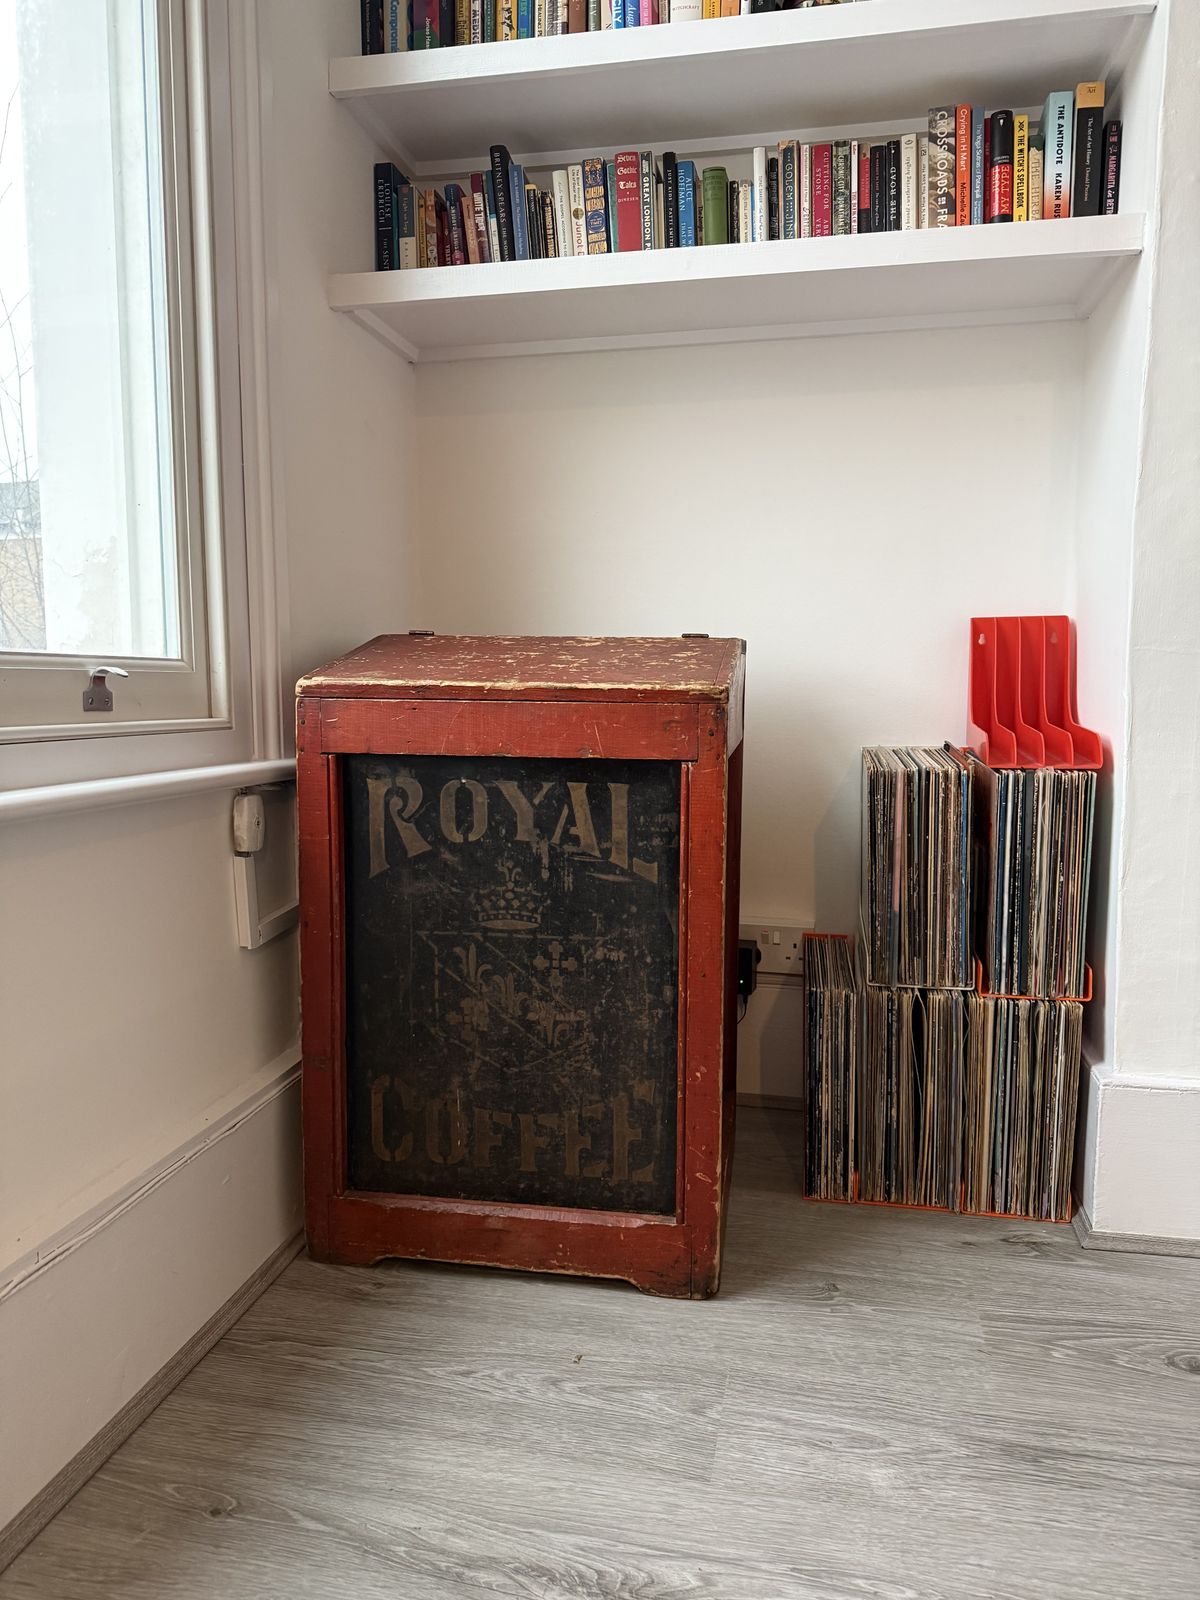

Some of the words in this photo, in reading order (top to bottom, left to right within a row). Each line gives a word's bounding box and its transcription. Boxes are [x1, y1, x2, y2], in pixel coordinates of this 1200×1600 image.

[937, 111, 948, 194] CROSSROADS
[1056, 124, 1064, 164] ANTIDOTE
[494, 152, 504, 190] BRITNEY
[619, 180, 636, 189] Tales
[1001, 166, 1009, 193] TYPE
[1032, 161, 1040, 180] THE
[1108, 155, 1117, 186] MARGARITA
[384, 183, 392, 218] LOUISE
[678, 170, 686, 211] HOFFMAN
[1054, 173, 1062, 201] KAREN
[498, 192, 506, 223] SPEARS
[937, 208, 948, 229] FRA
[1001, 197, 1009, 212] MY
[576, 222, 584, 248] Junot
[366, 775, 658, 884] ROYAL
[371, 1074, 655, 1185] COFFEE
